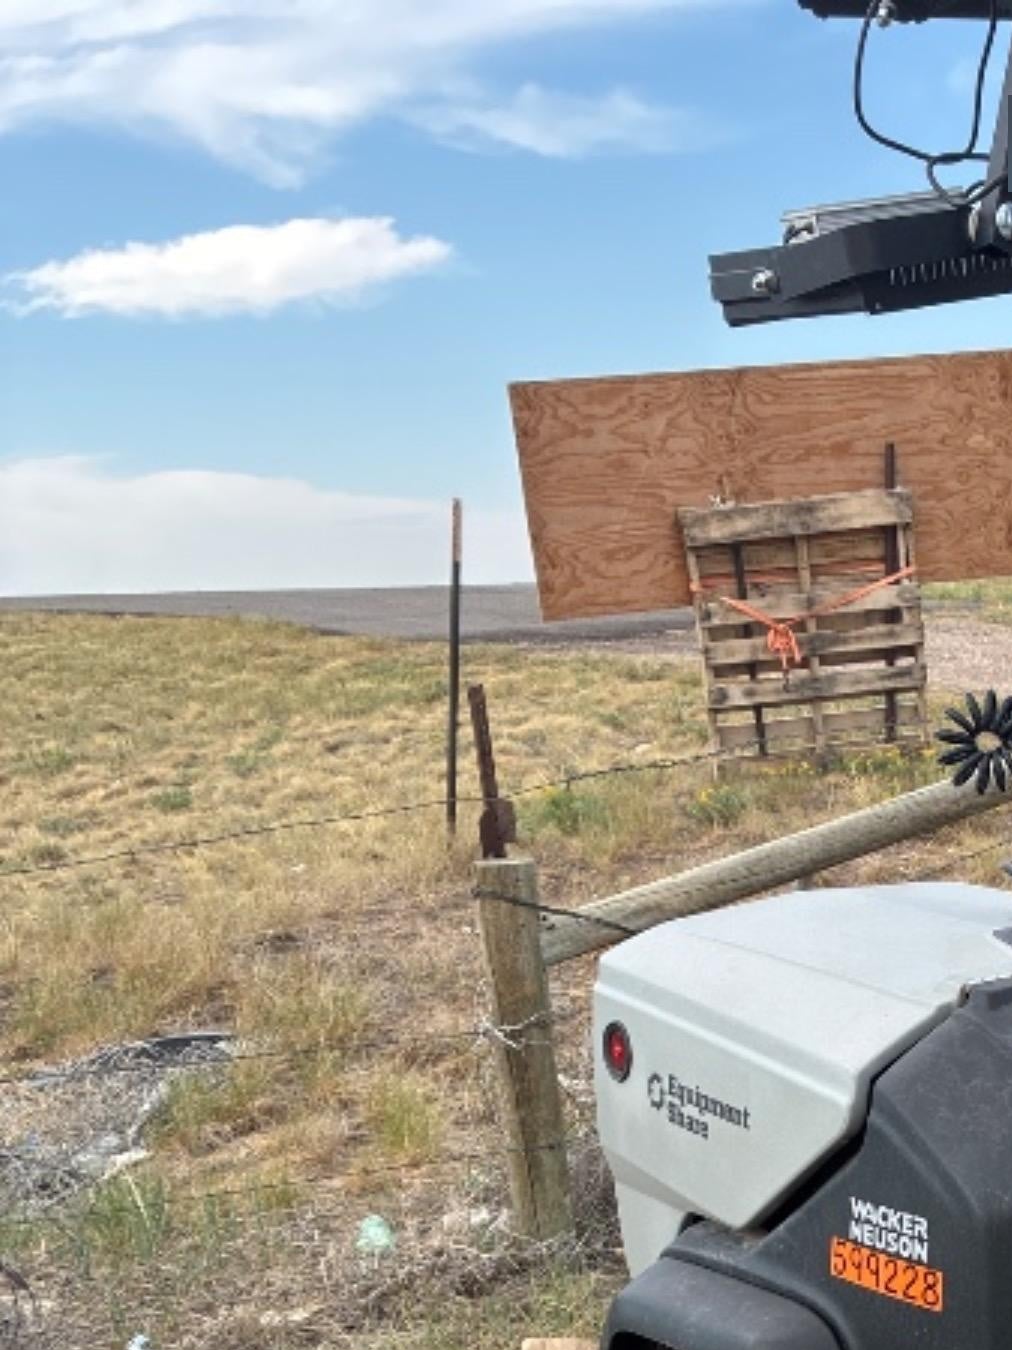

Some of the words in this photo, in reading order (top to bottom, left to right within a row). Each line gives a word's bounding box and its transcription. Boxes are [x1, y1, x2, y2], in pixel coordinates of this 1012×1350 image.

[668, 1073, 751, 1130] Equipment
[848, 1196, 928, 1240] WACKER
[848, 1220, 928, 1264] NEUSON
[833, 1241, 940, 1305] 599228
